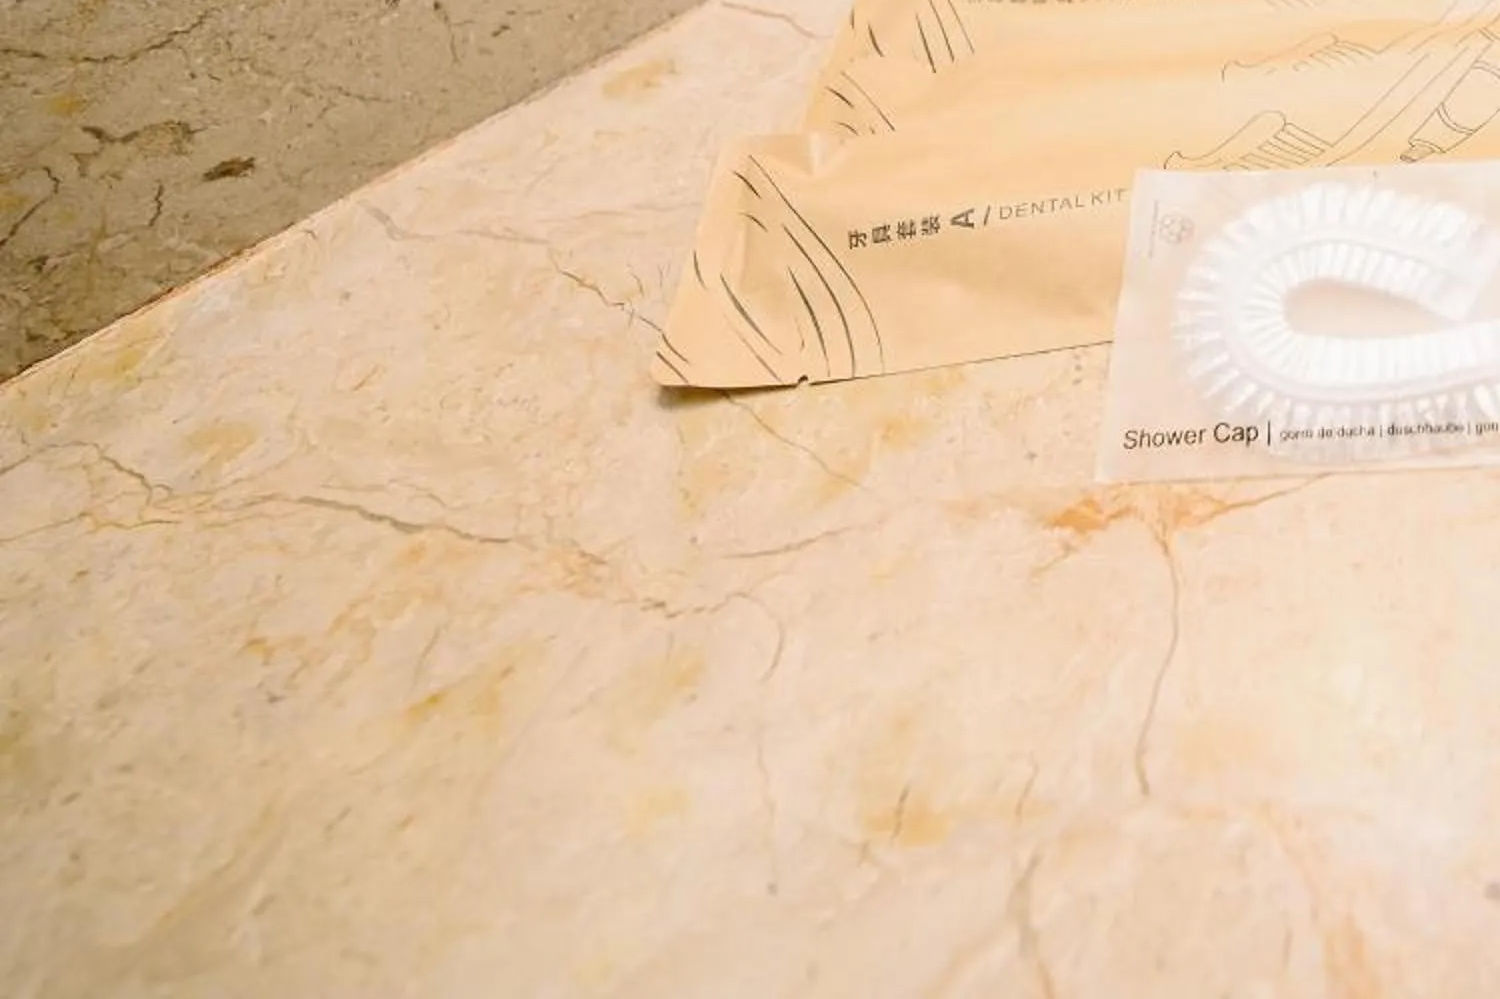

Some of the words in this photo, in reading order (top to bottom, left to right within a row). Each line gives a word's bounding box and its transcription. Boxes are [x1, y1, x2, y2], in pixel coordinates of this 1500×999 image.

[999, 194, 1085, 220] DENTAL
[1091, 187, 1128, 206] KIT
[1123, 427, 1206, 450] Shower
[1213, 422, 1259, 447] Cap
